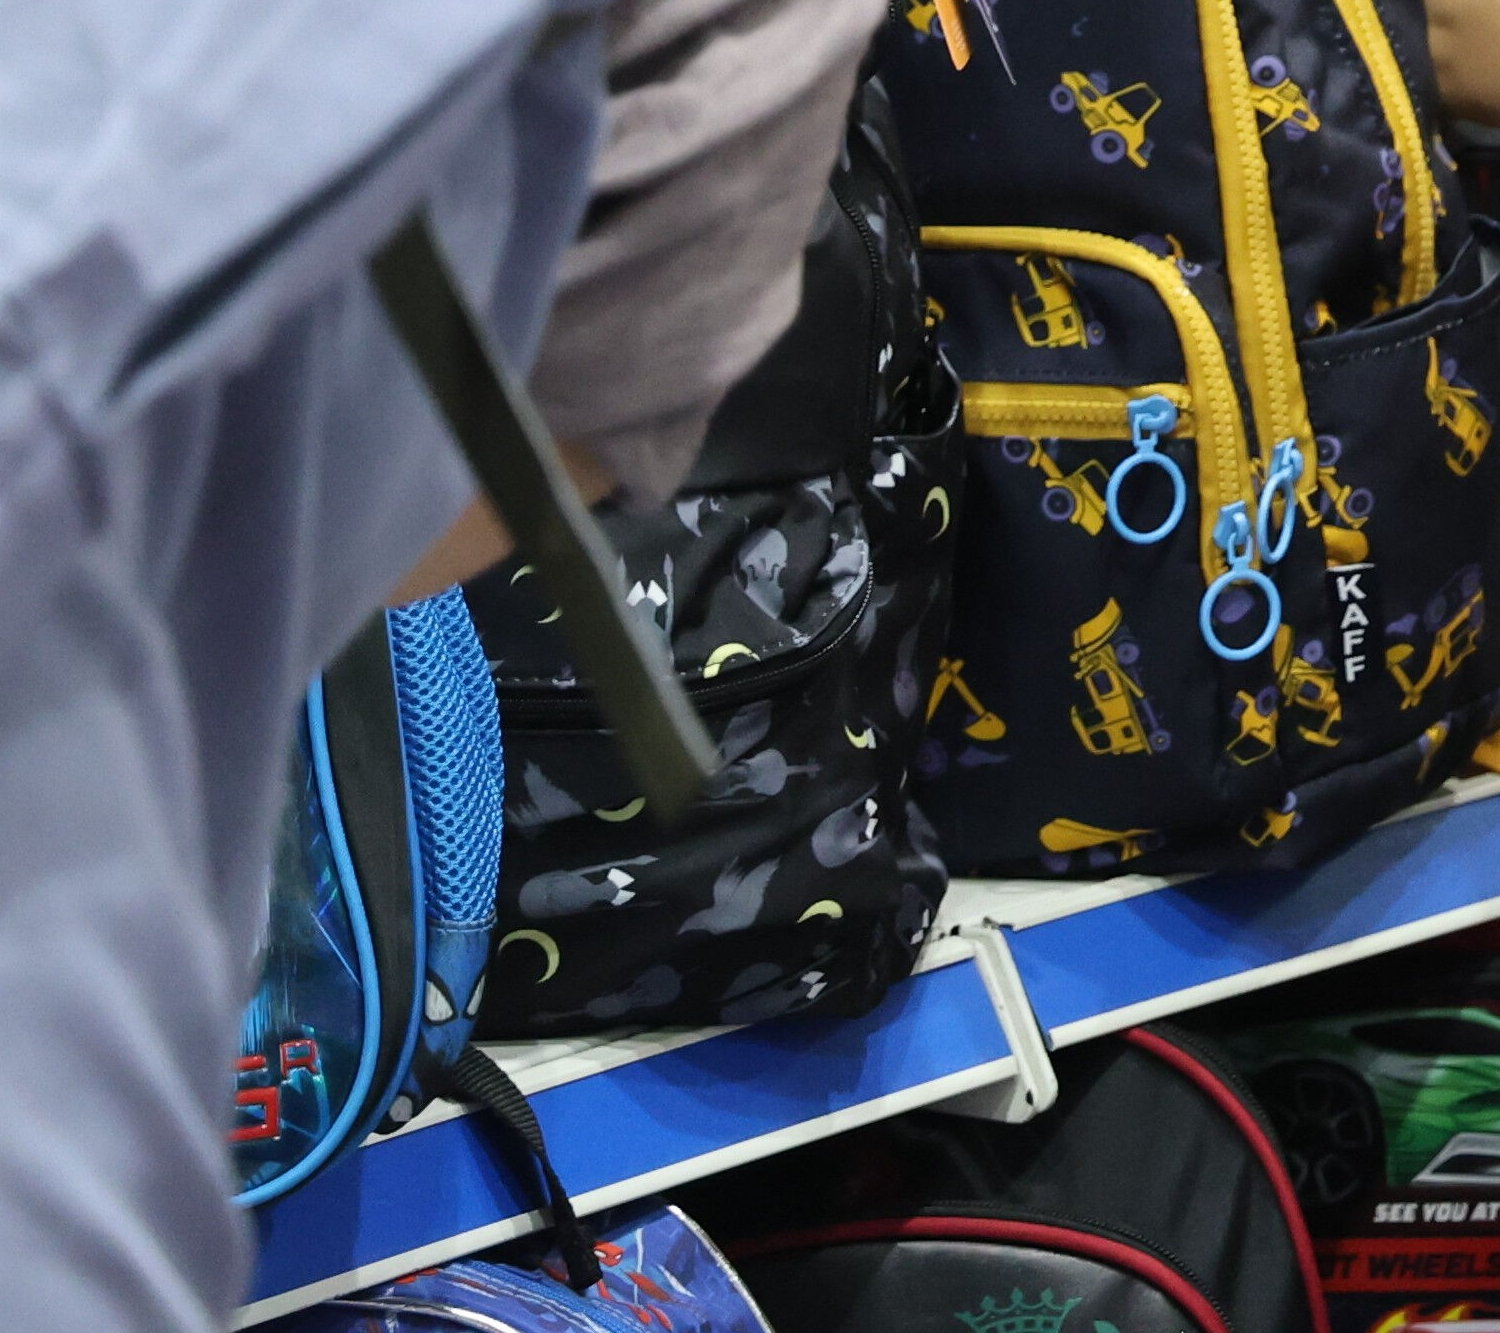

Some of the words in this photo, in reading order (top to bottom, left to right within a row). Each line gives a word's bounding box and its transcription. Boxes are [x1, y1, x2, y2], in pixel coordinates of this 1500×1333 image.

[1336, 573, 1370, 683] KAFF
[1373, 1202, 1418, 1223] SEE
[1423, 1201, 1469, 1223] YOU
